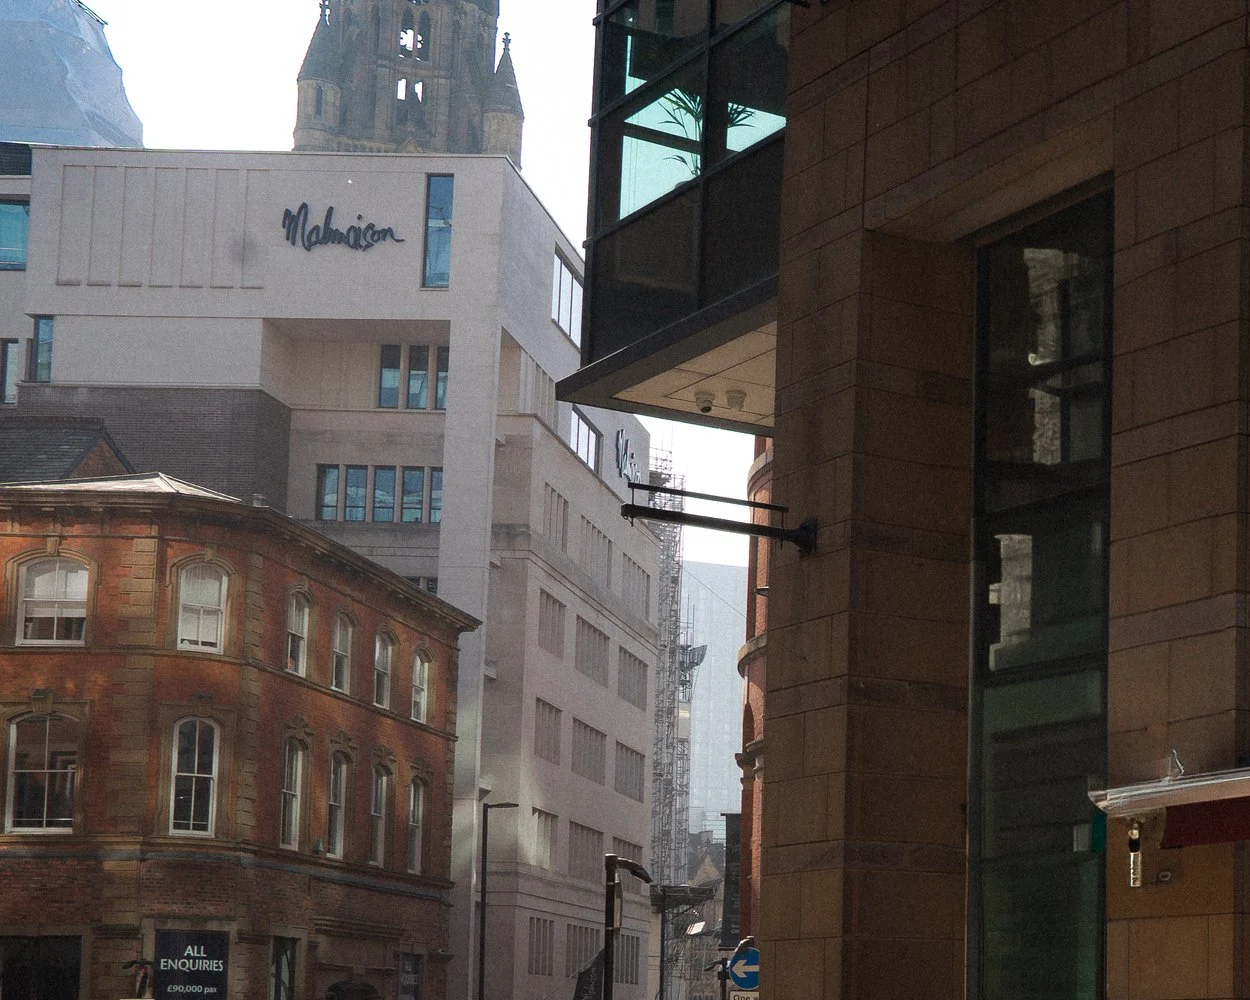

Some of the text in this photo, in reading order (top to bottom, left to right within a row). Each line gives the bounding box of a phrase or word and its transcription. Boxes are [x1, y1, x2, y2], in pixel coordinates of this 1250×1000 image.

[281, 202, 405, 252] Malmaison
[184, 945, 207, 957] ALL
[160, 958, 224, 972] ENQUIRIES
[166, 984, 217, 995] £90,000 pax
